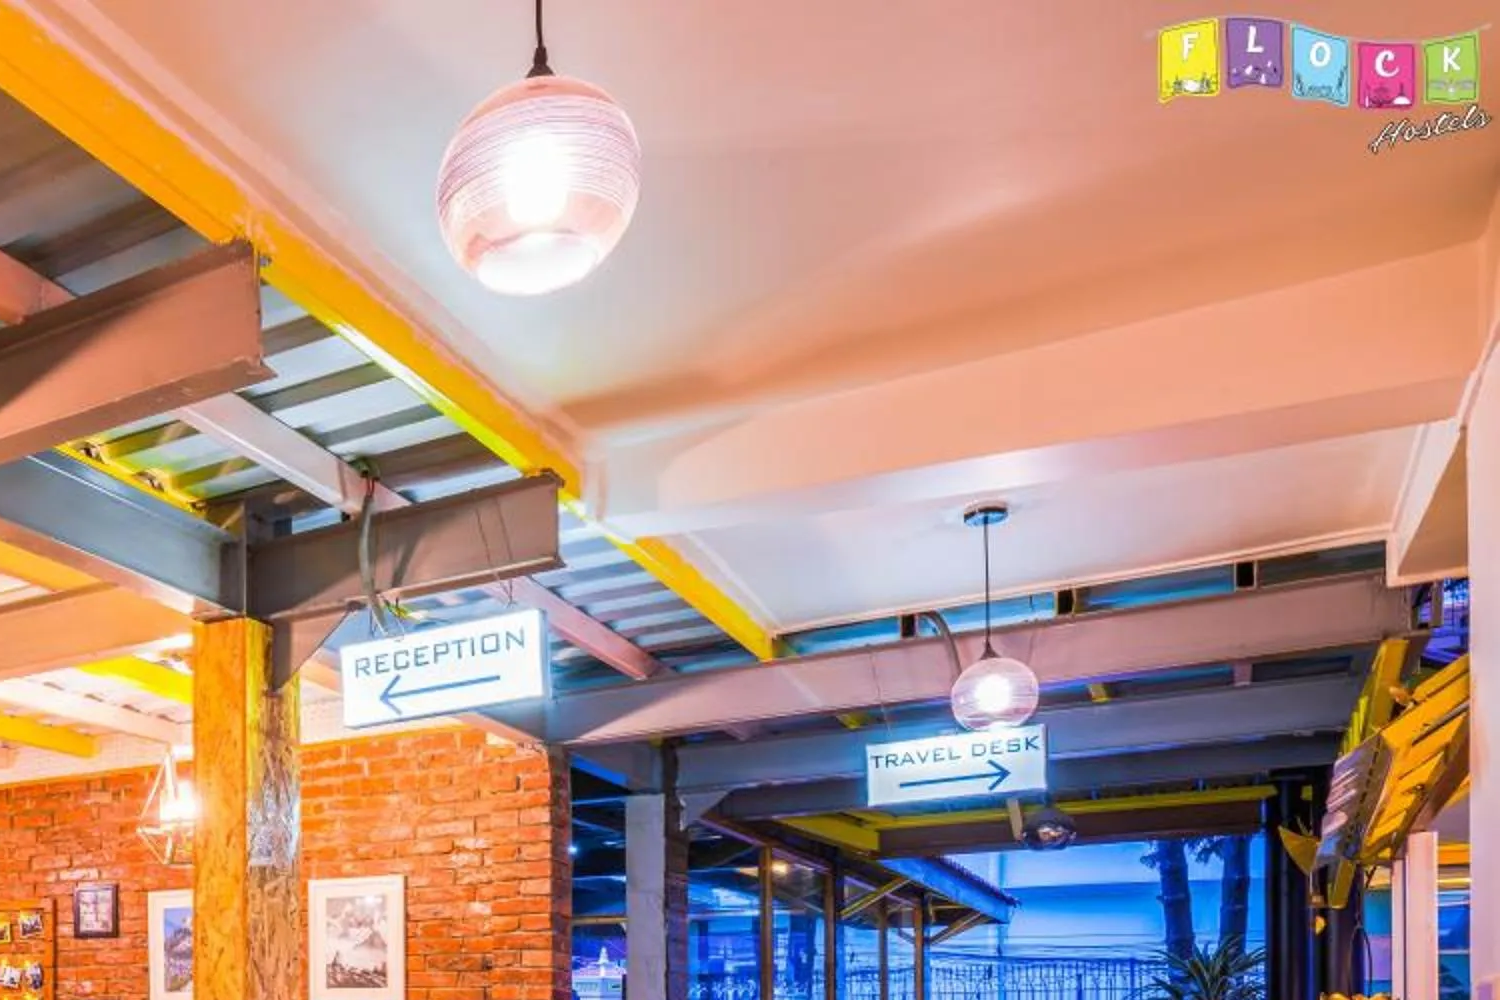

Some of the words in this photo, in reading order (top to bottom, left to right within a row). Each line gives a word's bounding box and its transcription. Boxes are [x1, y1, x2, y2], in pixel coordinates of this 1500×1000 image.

[354, 627, 526, 678] RECEPTION
[870, 747, 962, 770] TRAVEL
[971, 735, 1040, 758] DESK
